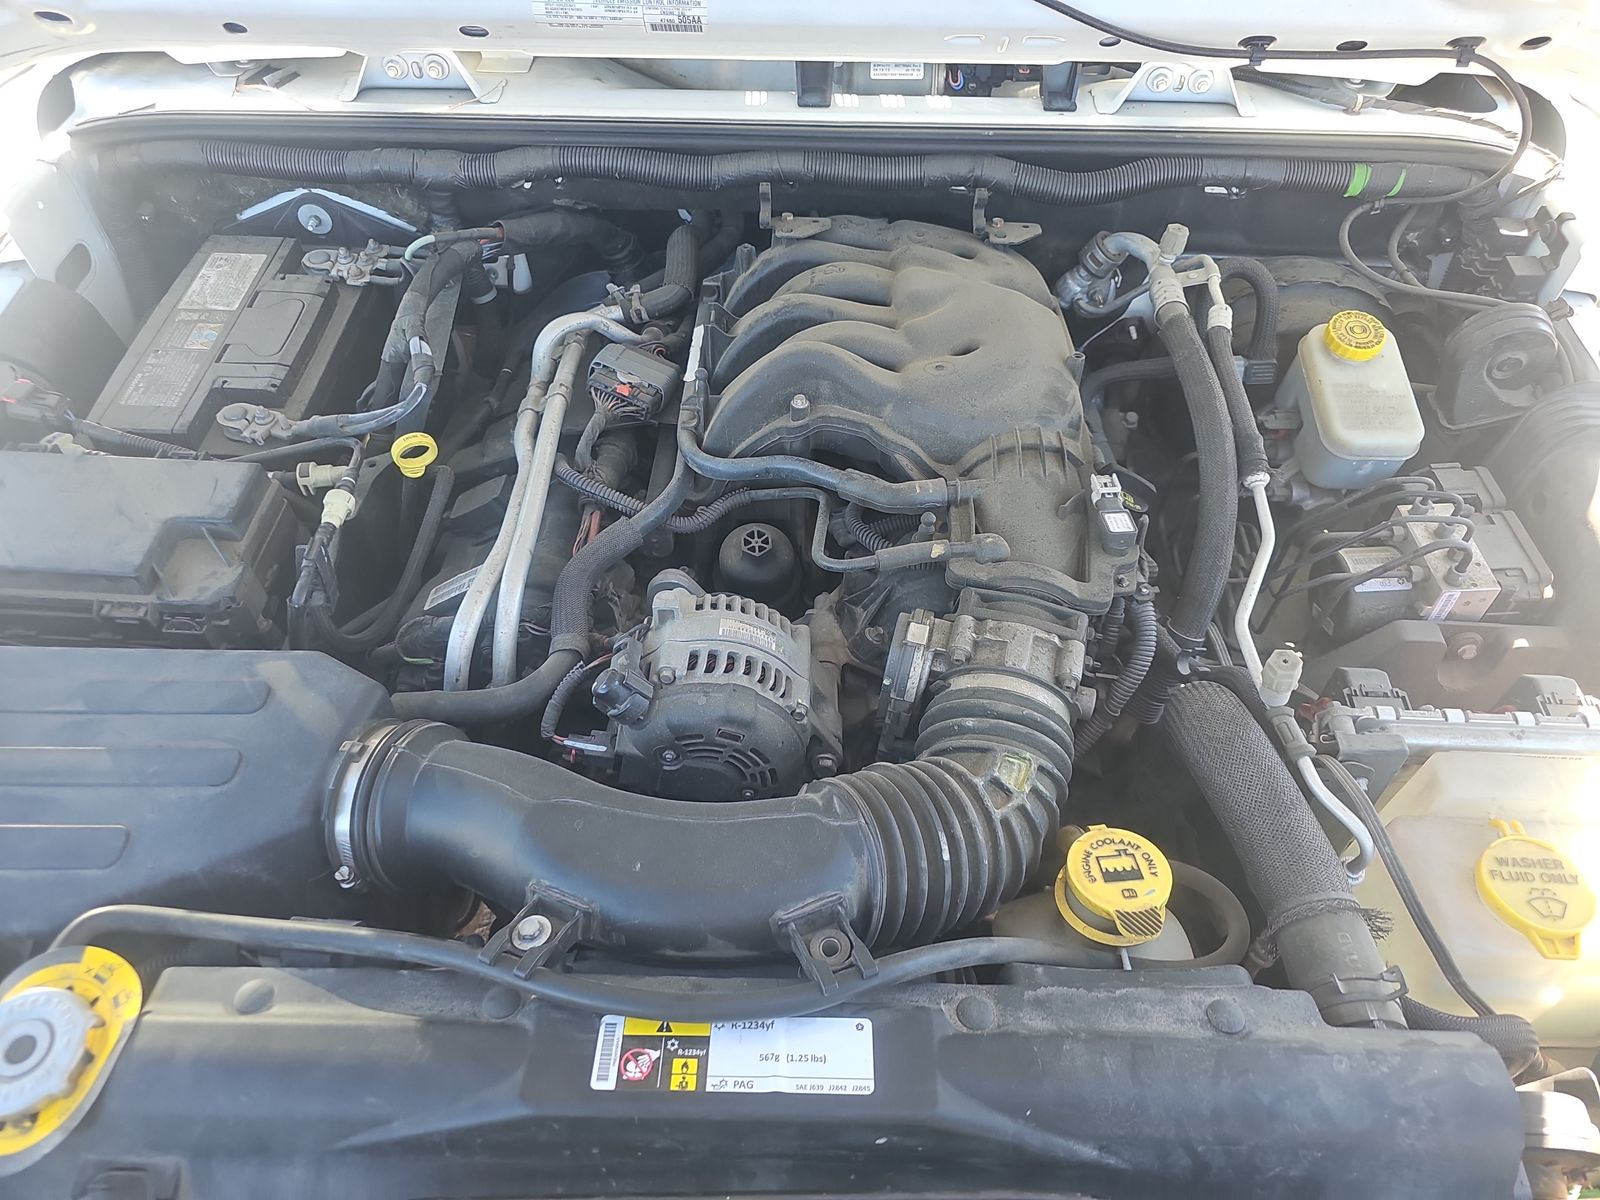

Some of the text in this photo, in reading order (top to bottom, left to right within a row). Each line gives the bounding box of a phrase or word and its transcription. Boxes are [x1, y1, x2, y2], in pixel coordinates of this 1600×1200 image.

[677, 15, 703, 25] 505AA
[1081, 837, 1159, 884] ENGINE COOLANT ONLY
[1495, 856, 1565, 870] WASHER
[1490, 870, 1579, 884] FLUID ONLY
[731, 1019, 775, 1031] R-1234yf
[677, 1048, 707, 1056] R-1234yf
[759, 1052, 780, 1062] 567g
[811, 1053, 827, 1064] lbs)
[733, 1080, 754, 1089] PAG
[795, 1083, 808, 1091] SAE
